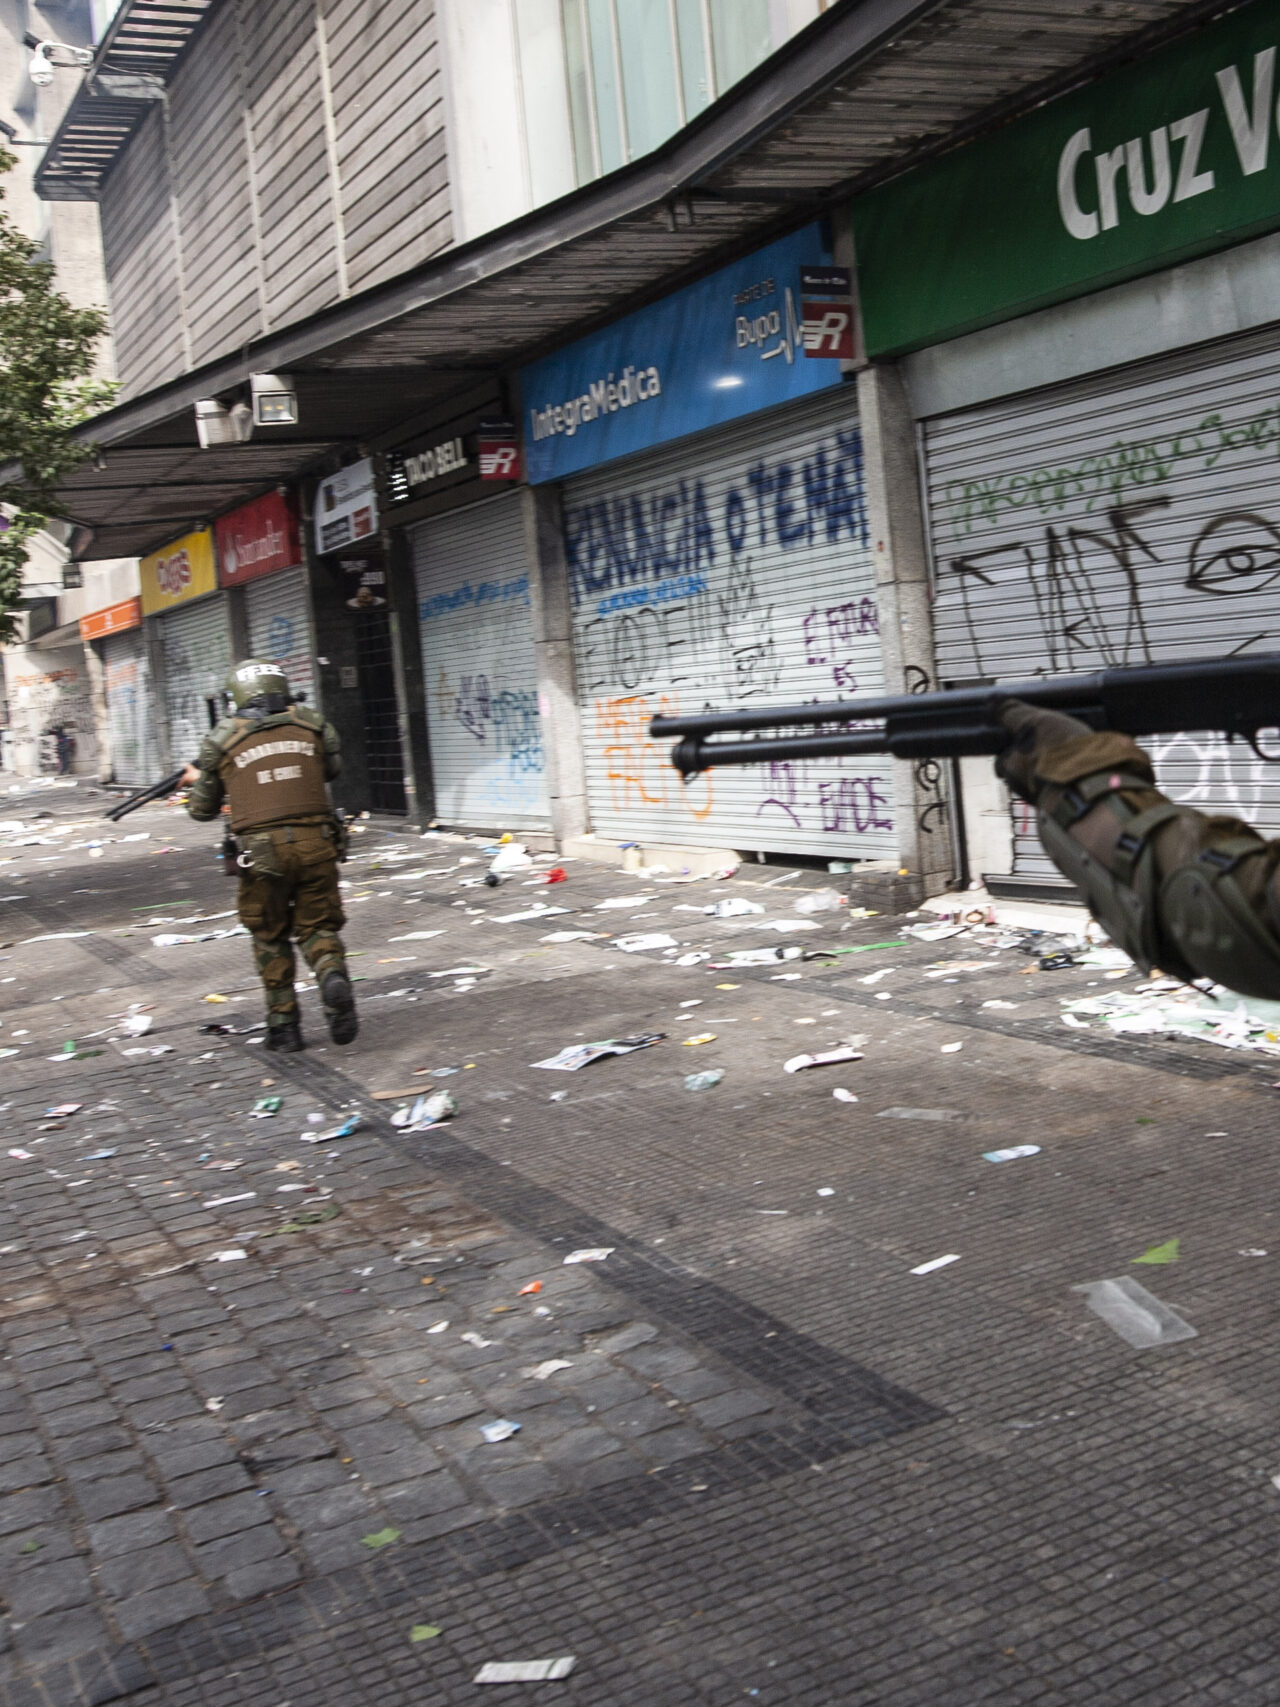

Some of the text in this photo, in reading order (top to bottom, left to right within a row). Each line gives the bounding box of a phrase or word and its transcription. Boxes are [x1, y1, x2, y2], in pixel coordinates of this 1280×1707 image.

[1057, 108, 1216, 241] Cruz
[736, 309, 781, 349] Bupa
[530, 364, 662, 442] IntegraMédica
[404, 437, 469, 487] TACO BELL
[256, 769, 273, 784] DE
